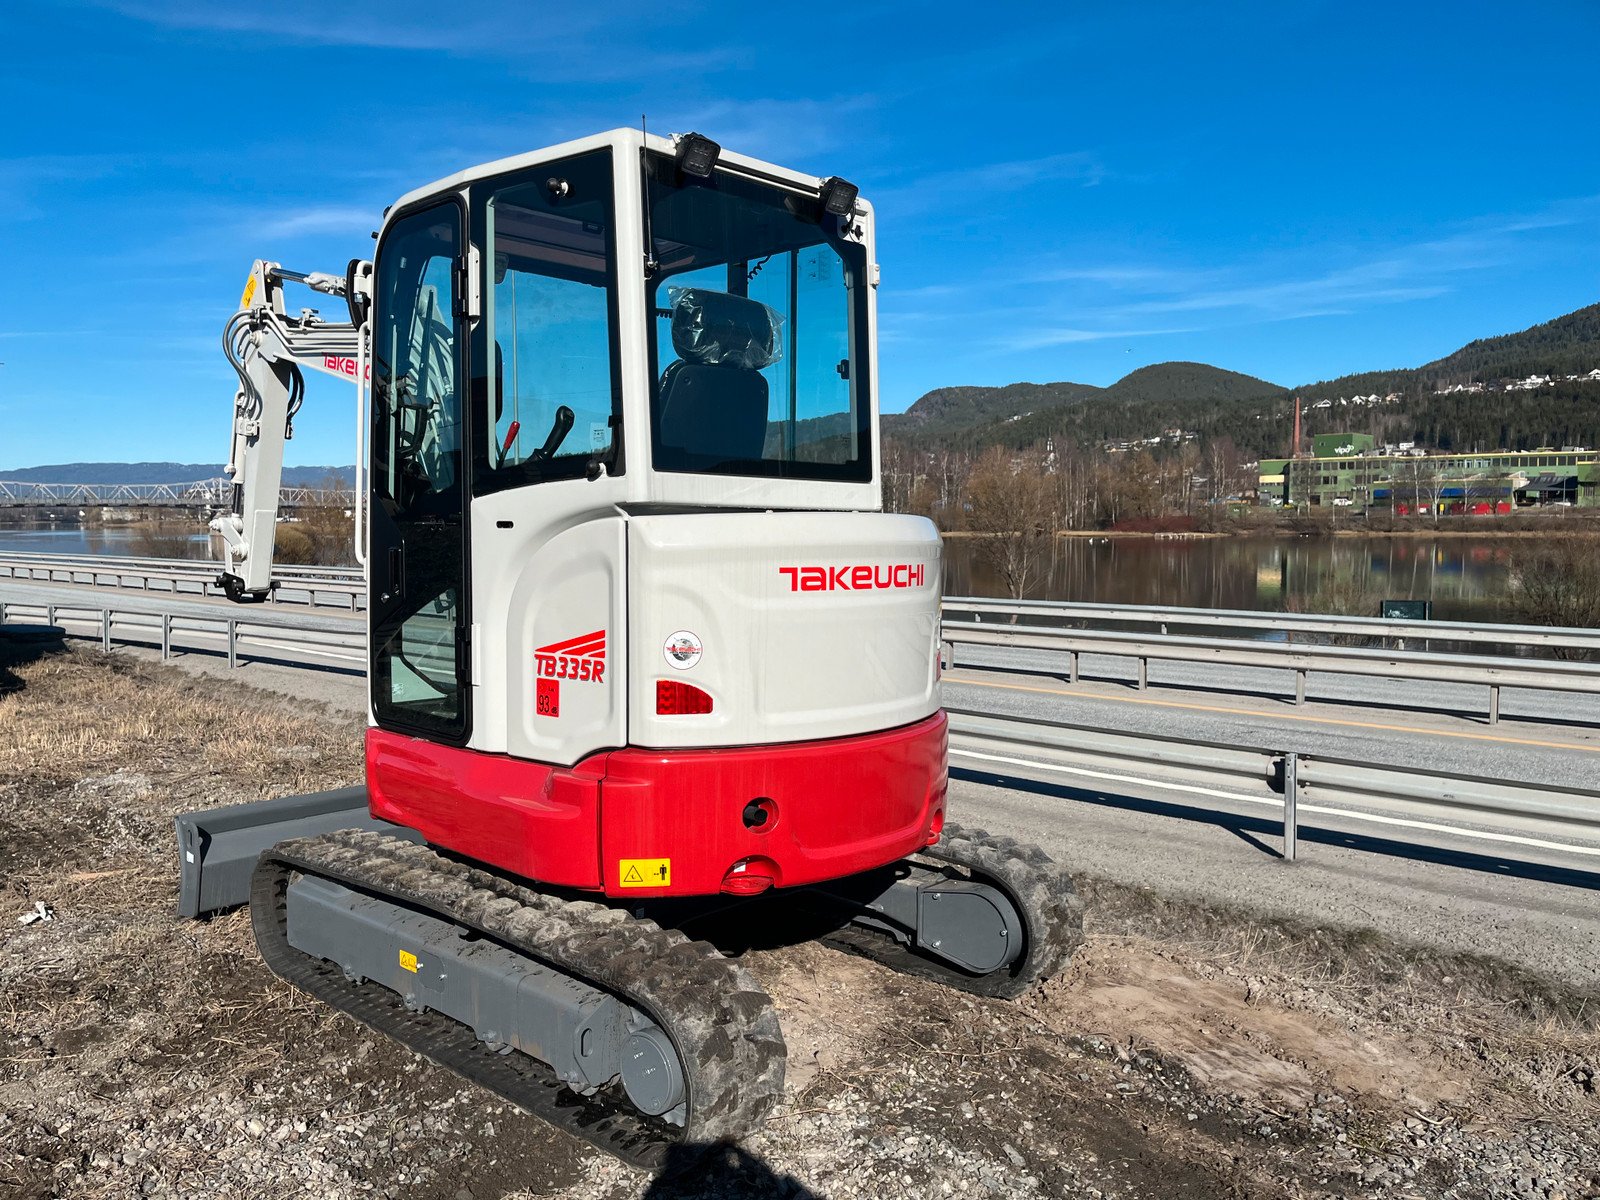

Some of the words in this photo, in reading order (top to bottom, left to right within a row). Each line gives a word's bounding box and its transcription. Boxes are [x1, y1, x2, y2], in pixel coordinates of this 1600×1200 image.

[779, 564, 924, 592] TAKEUCHI
[534, 654, 605, 683] TB335R
[539, 694, 550, 713] 93
